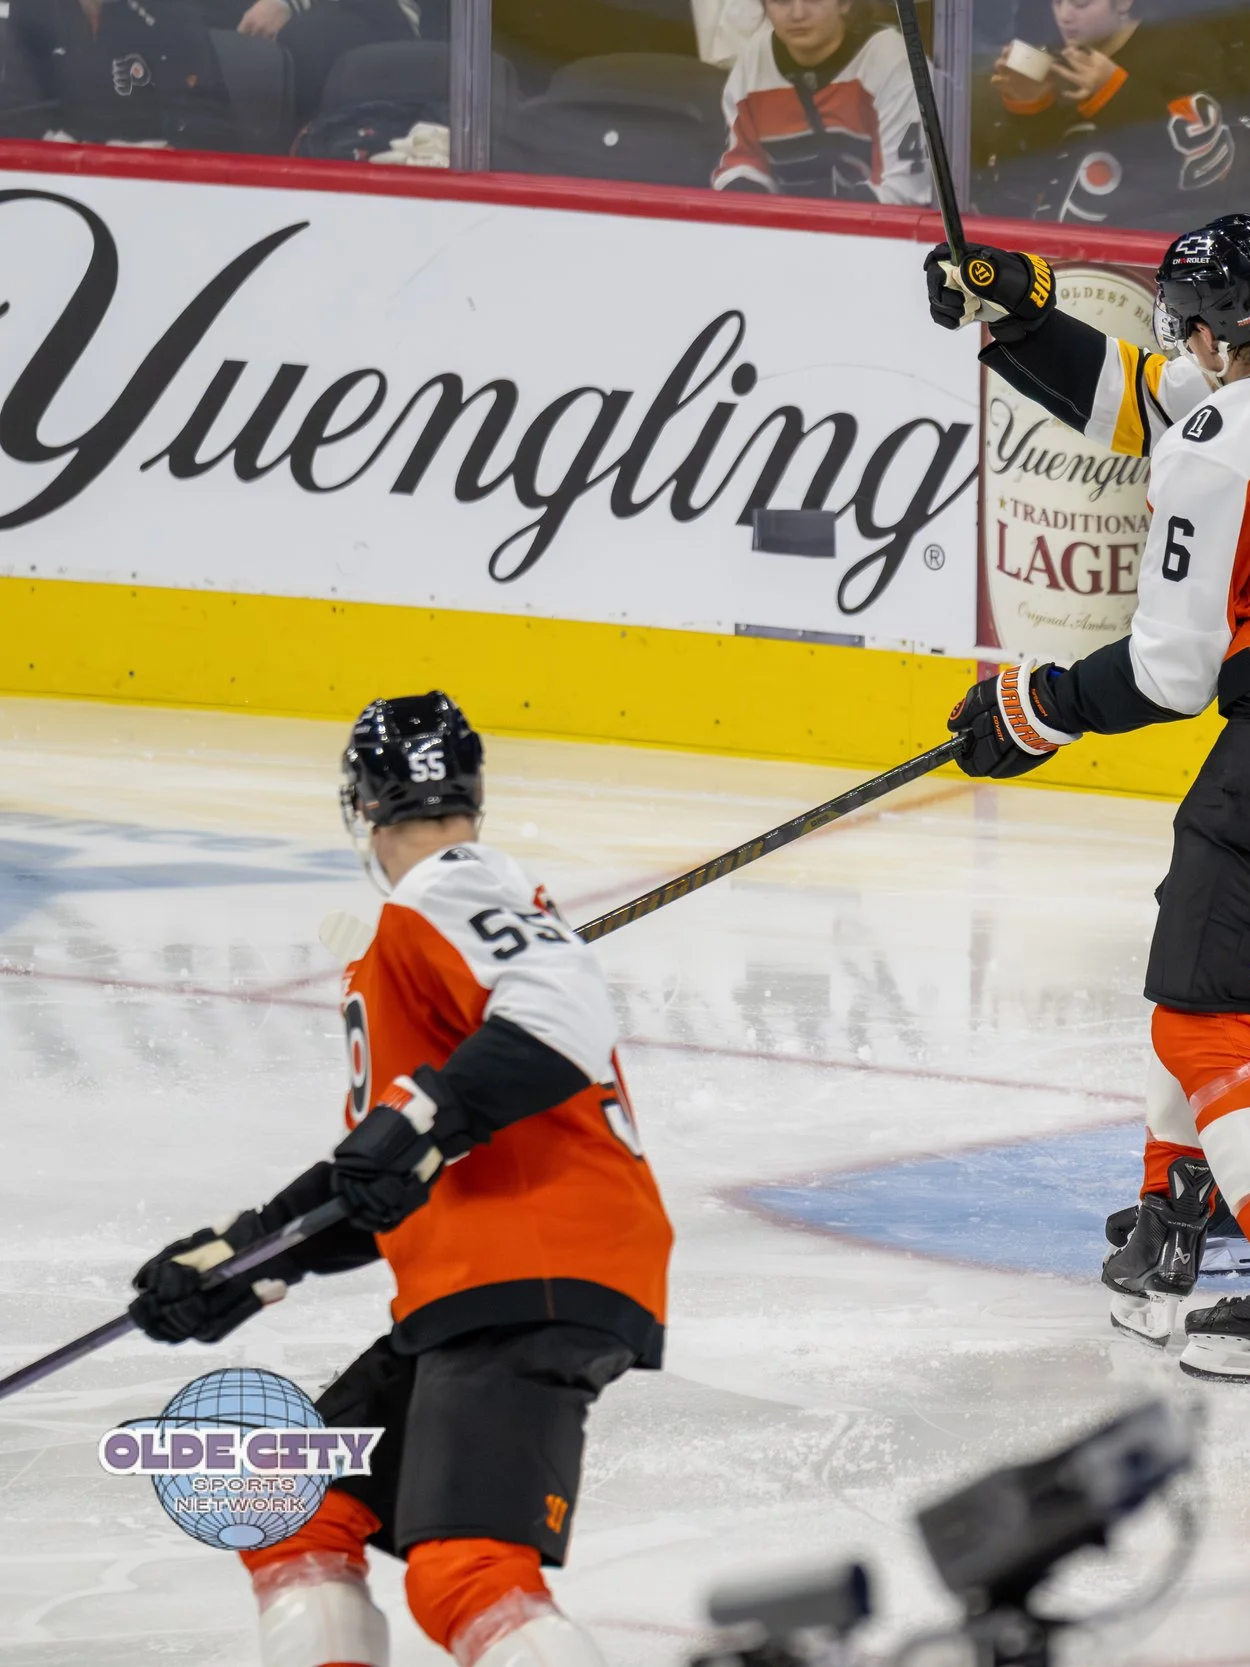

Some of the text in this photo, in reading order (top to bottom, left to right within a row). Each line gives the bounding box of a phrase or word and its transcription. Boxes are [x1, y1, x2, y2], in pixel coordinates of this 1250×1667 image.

[1061, 286, 1128, 308] OLDEST
[0, 189, 978, 614] Yuengling
[1010, 498, 1149, 534] TRADITIONA
[996, 519, 1141, 597] LAGE
[1162, 515, 1195, 582] 6
[1017, 601, 1071, 628] Original
[408, 750, 446, 783] 55
